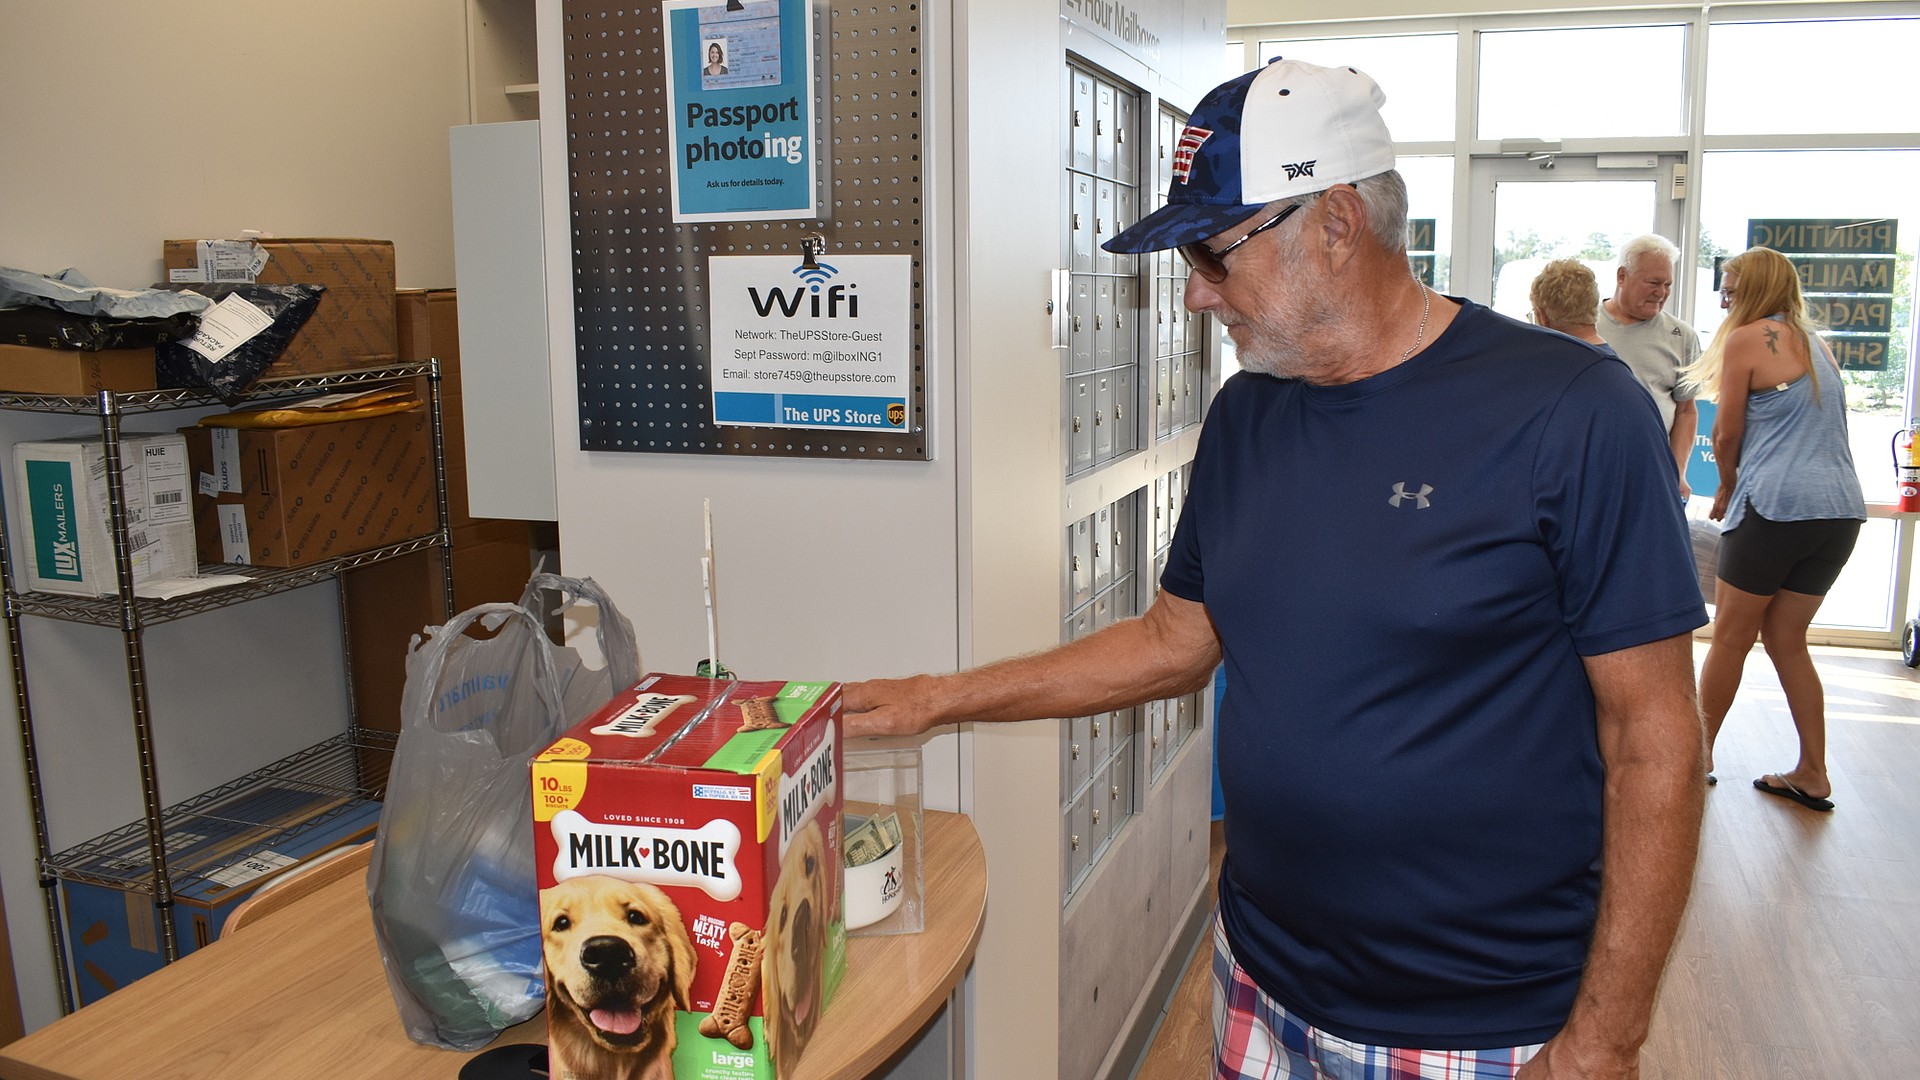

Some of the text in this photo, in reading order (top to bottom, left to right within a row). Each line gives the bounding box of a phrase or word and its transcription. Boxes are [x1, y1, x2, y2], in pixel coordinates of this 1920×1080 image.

[1115, 1, 1160, 60] Mailboxes
[687, 97, 798, 131] Passport
[686, 132, 802, 169] photoing
[707, 177, 784, 189] Ask us for details today.
[196, 328, 226, 350] PACKAG
[735, 329, 883, 342] Network: TheUPSStore-Guest
[734, 349, 757, 362] Sept
[759, 350, 810, 362] Password:
[723, 369, 896, 384] Email: store7459@theupsstore.com
[784, 407, 882, 425] The UPS Store
[888, 408, 904, 423] ups
[145, 447, 166, 457] HUIE
[1701, 451, 1716, 462] Yo
[53, 483, 67, 542] MAILERS
[52, 540, 80, 577] LUX
[610, 715, 652, 733] MILK
[636, 697, 680, 713] BONE
[540, 777, 559, 791] 10
[545, 795, 569, 804] 100+
[783, 773, 808, 842] MILK
[811, 744, 832, 799] BONE
[604, 814, 685, 825] LOVED SINCE 1908
[569, 833, 725, 879] MILK BONE
[242, 861, 270, 872] 1002
[693, 918, 727, 940] MEATY
[695, 932, 719, 949] Taste
[712, 1051, 754, 1069] large
[705, 1068, 755, 1078] crunchy texture
